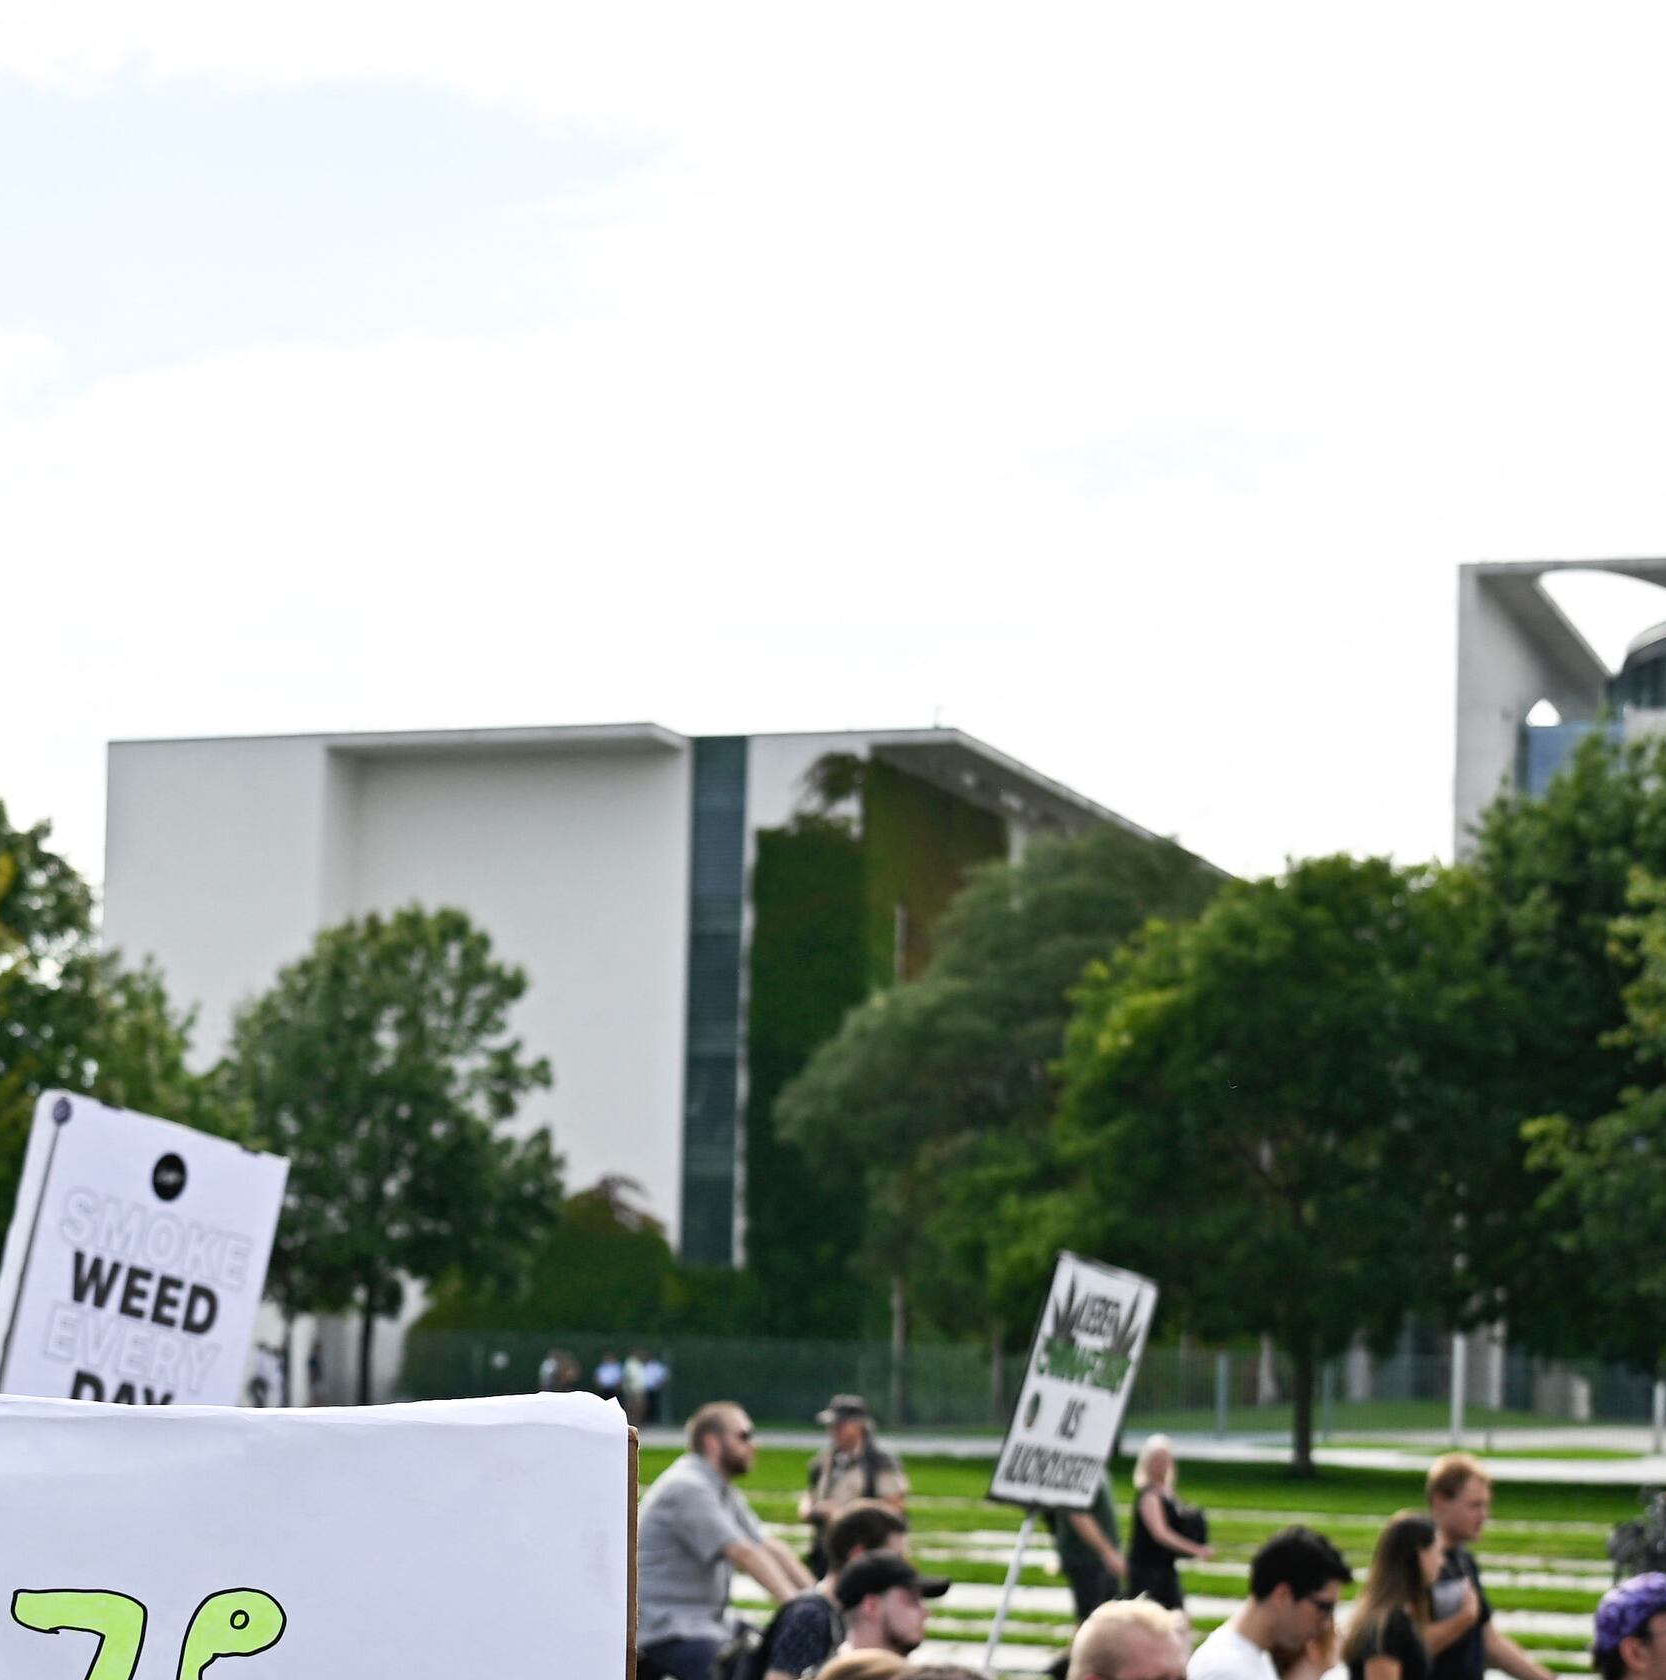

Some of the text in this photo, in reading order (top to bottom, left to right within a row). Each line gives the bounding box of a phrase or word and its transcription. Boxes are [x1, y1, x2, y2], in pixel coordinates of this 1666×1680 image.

[59, 1185, 254, 1292] SMOKE
[72, 1250, 219, 1335] WEED
[44, 1299, 222, 1395] EVERY
